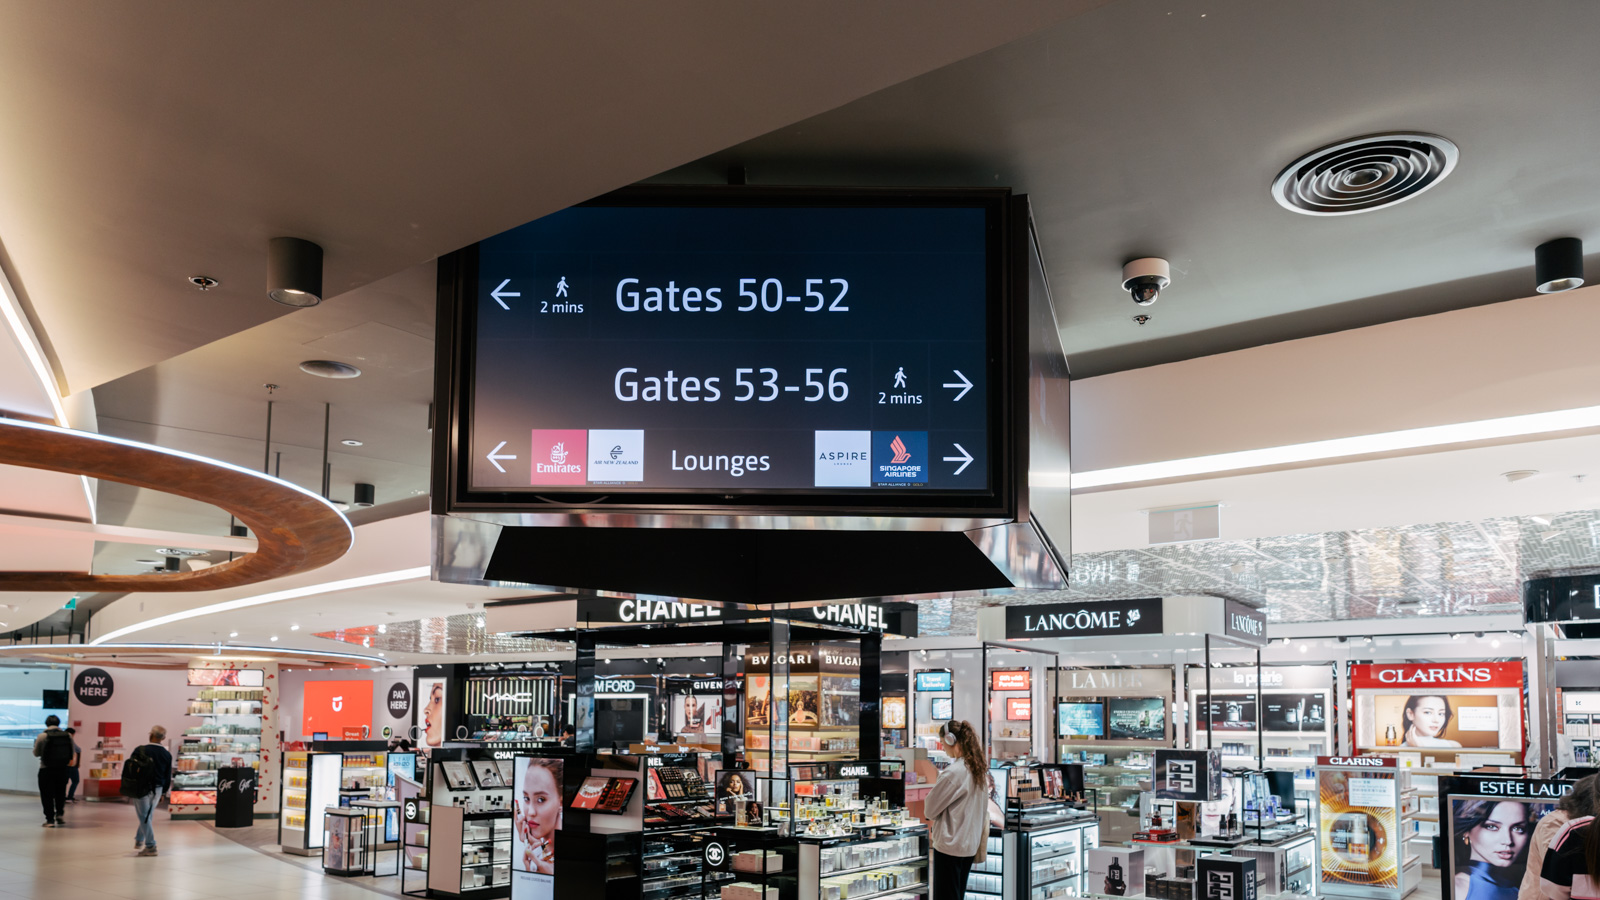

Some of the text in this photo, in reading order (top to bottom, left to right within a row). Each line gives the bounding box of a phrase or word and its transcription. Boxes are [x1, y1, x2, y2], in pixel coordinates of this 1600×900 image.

[616, 278, 850, 312] Gates 50-52
[540, 302, 584, 314] 2 mins
[614, 367, 849, 402] Gates 53-56
[878, 392, 923, 404] 2 mins
[819, 452, 867, 460] ASPIRE
[536, 463, 581, 473] Emirates
[671, 449, 770, 477] Lounges
[619, 600, 721, 622] CHANEL
[812, 603, 888, 629] CHANEL
[1024, 609, 1121, 632] LANCÔME
[84, 676, 106, 685] PAY
[1072, 672, 1143, 689] LA MER
[1378, 668, 1492, 683] CLARINS
[80, 686, 108, 697] HERE
[605, 680, 636, 692] FORD
[693, 681, 742, 690] GIVENY
[392, 690, 406, 700] PAY
[390, 701, 408, 710] HERE
[1329, 757, 1384, 766] CLARINS
[840, 766, 869, 776] CHANEL
[1530, 783, 1575, 797] LAUD
